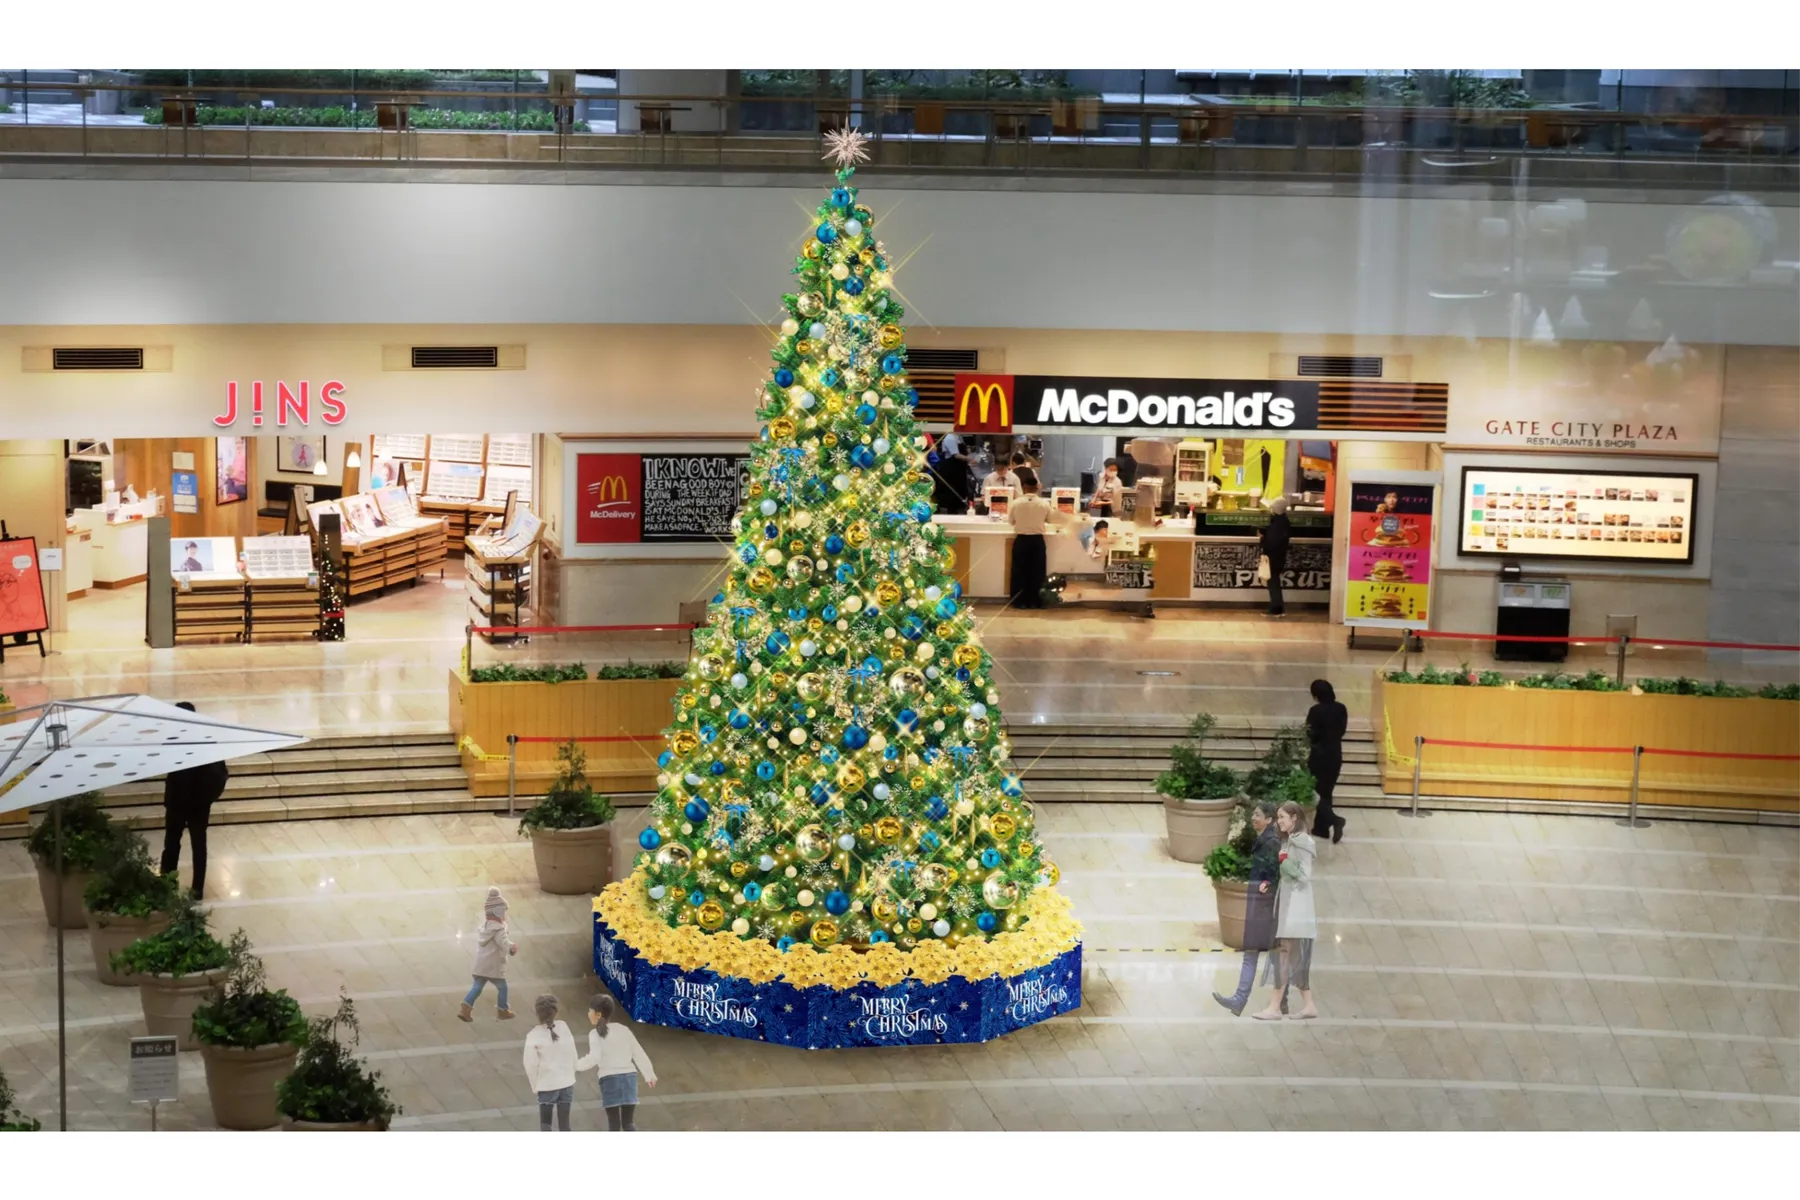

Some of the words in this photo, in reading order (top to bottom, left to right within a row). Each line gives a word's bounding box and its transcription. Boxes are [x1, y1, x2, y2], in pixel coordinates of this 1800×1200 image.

[1037, 388, 1296, 428] McDonald's
[1485, 420, 1540, 436] GATE
[1551, 421, 1603, 437] CITY
[1612, 424, 1678, 440] PLAZA
[1526, 437, 1594, 447] RESTAURANTS
[1595, 439, 1602, 447] &
[1604, 439, 1636, 448] SHOPS
[645, 479, 672, 490] BEEN
[708, 479, 726, 489] BOY
[590, 510, 636, 520] McDelivery
[657, 515, 676, 523] SAYS
[671, 978, 720, 1002] MERRY
[1006, 974, 1045, 1003] MERRY
[669, 996, 759, 1029] CHRISTMAS
[857, 994, 910, 1017] MERRY
[1006, 983, 1067, 1021] CHRISTMAS
[857, 1007, 948, 1039] CHRISTMAS
